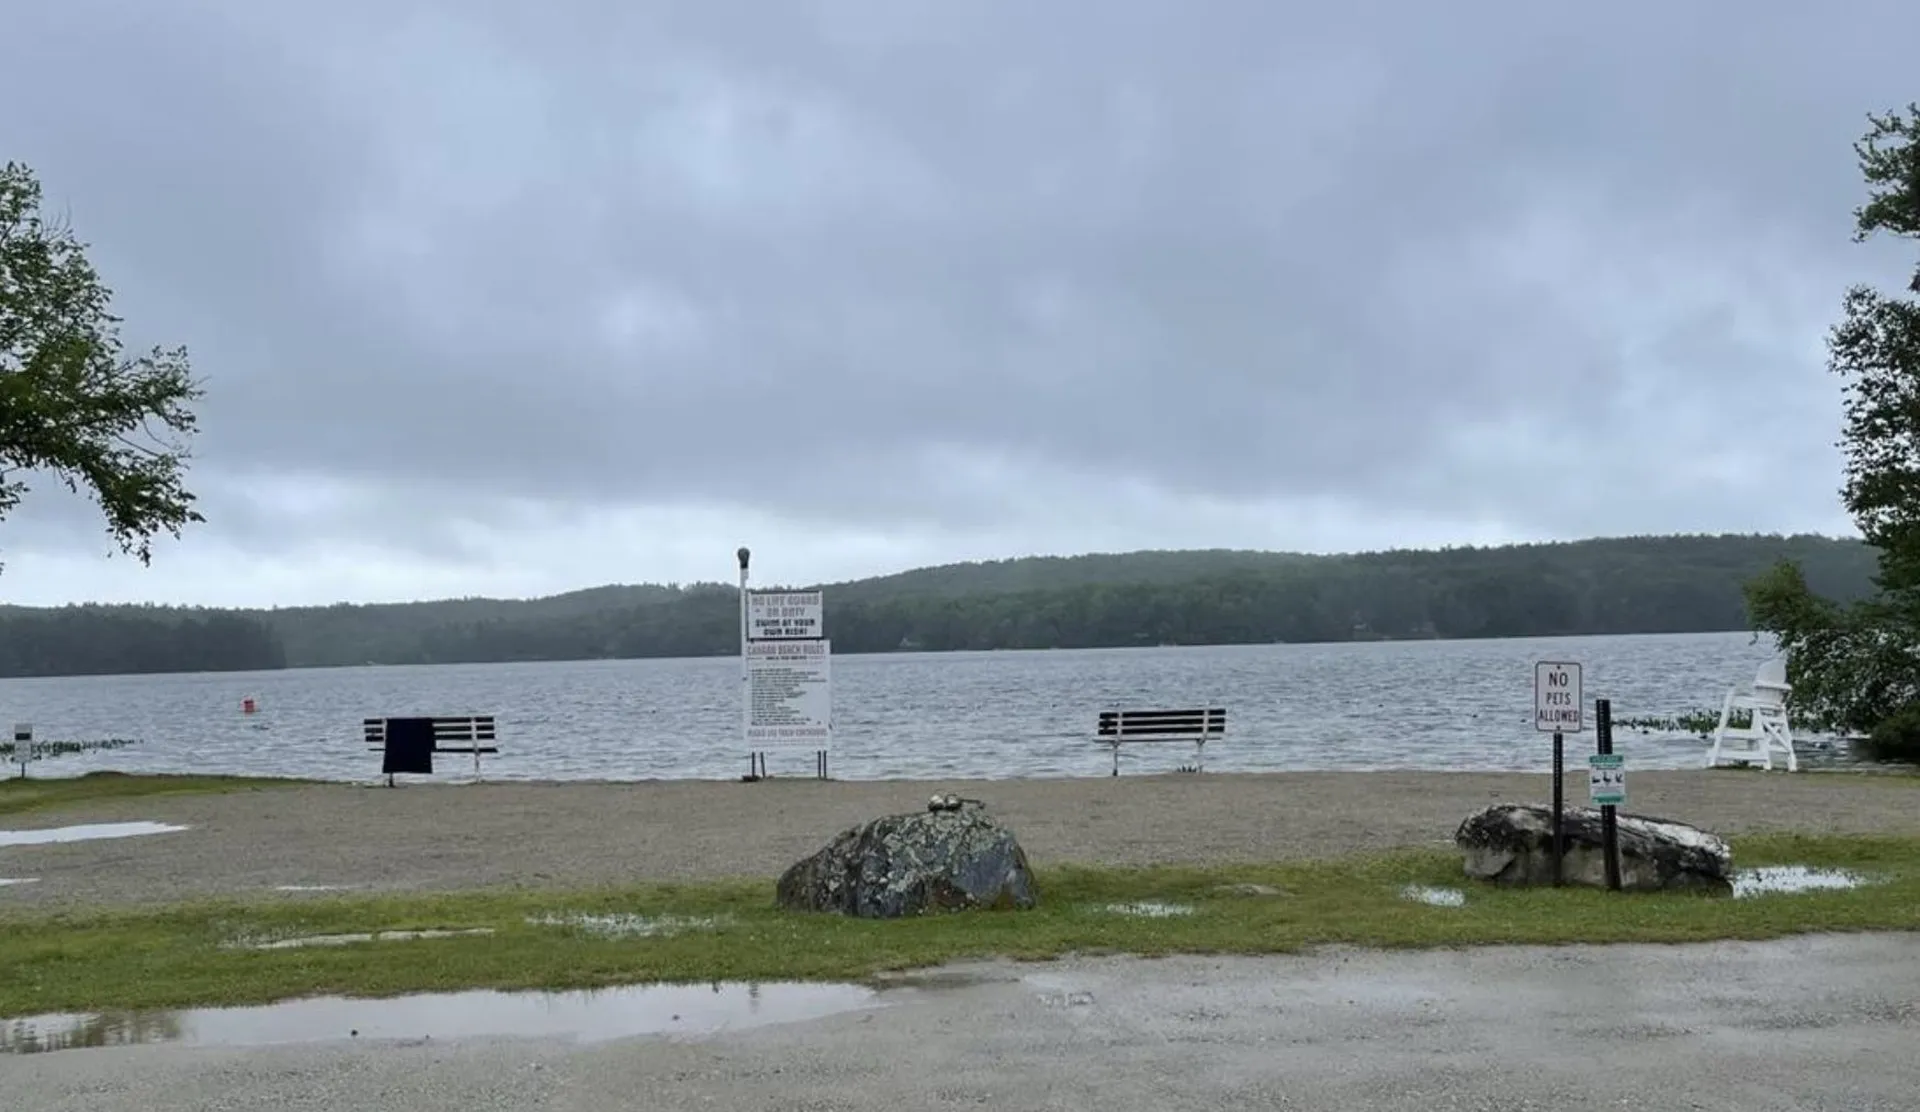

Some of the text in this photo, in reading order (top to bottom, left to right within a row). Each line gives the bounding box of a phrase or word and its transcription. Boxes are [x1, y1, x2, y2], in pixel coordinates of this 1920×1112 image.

[782, 607, 805, 617] DUTY
[782, 618, 791, 626] AT
[793, 618, 815, 626] YOUR
[1549, 672, 1569, 687] NO
[1546, 692, 1571, 706] PETS
[1538, 709, 1580, 722] ALLOWED
